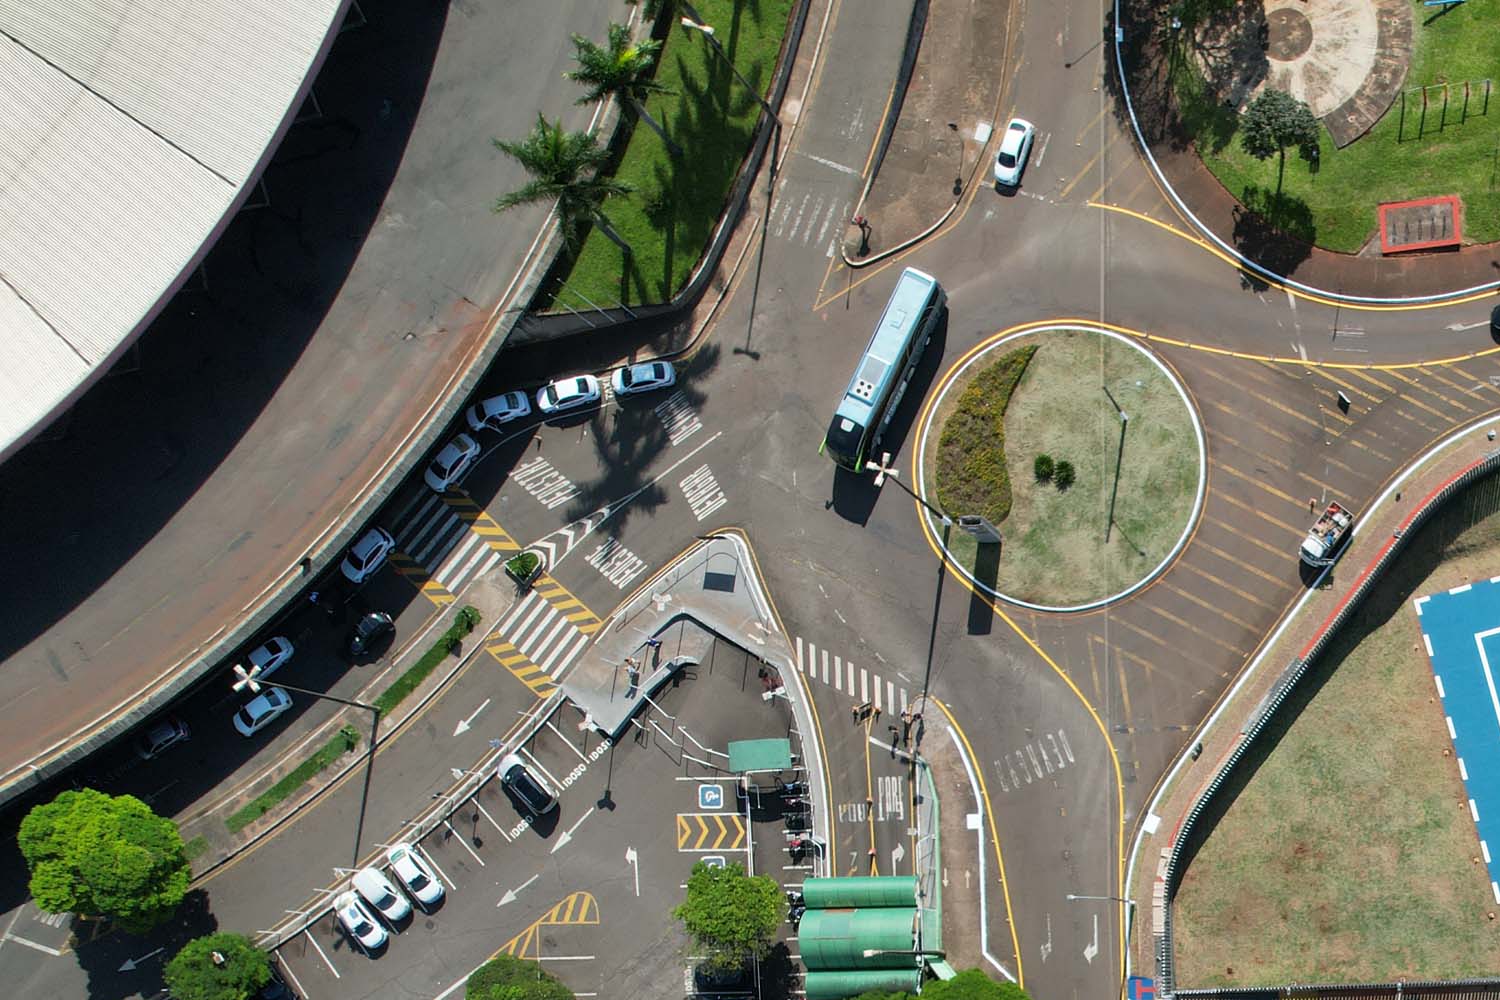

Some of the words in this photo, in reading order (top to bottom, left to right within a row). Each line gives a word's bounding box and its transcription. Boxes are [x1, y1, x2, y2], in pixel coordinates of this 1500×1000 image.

[654, 391, 703, 446] DEVAGAR
[508, 456, 582, 510] PEDESTRE
[679, 464, 728, 521] DEVAGAR
[584, 536, 648, 590] PEDESTRE
[562, 763, 587, 788] IDOSO
[589, 737, 613, 762] IDOSO
[509, 815, 534, 839] IDOSO
